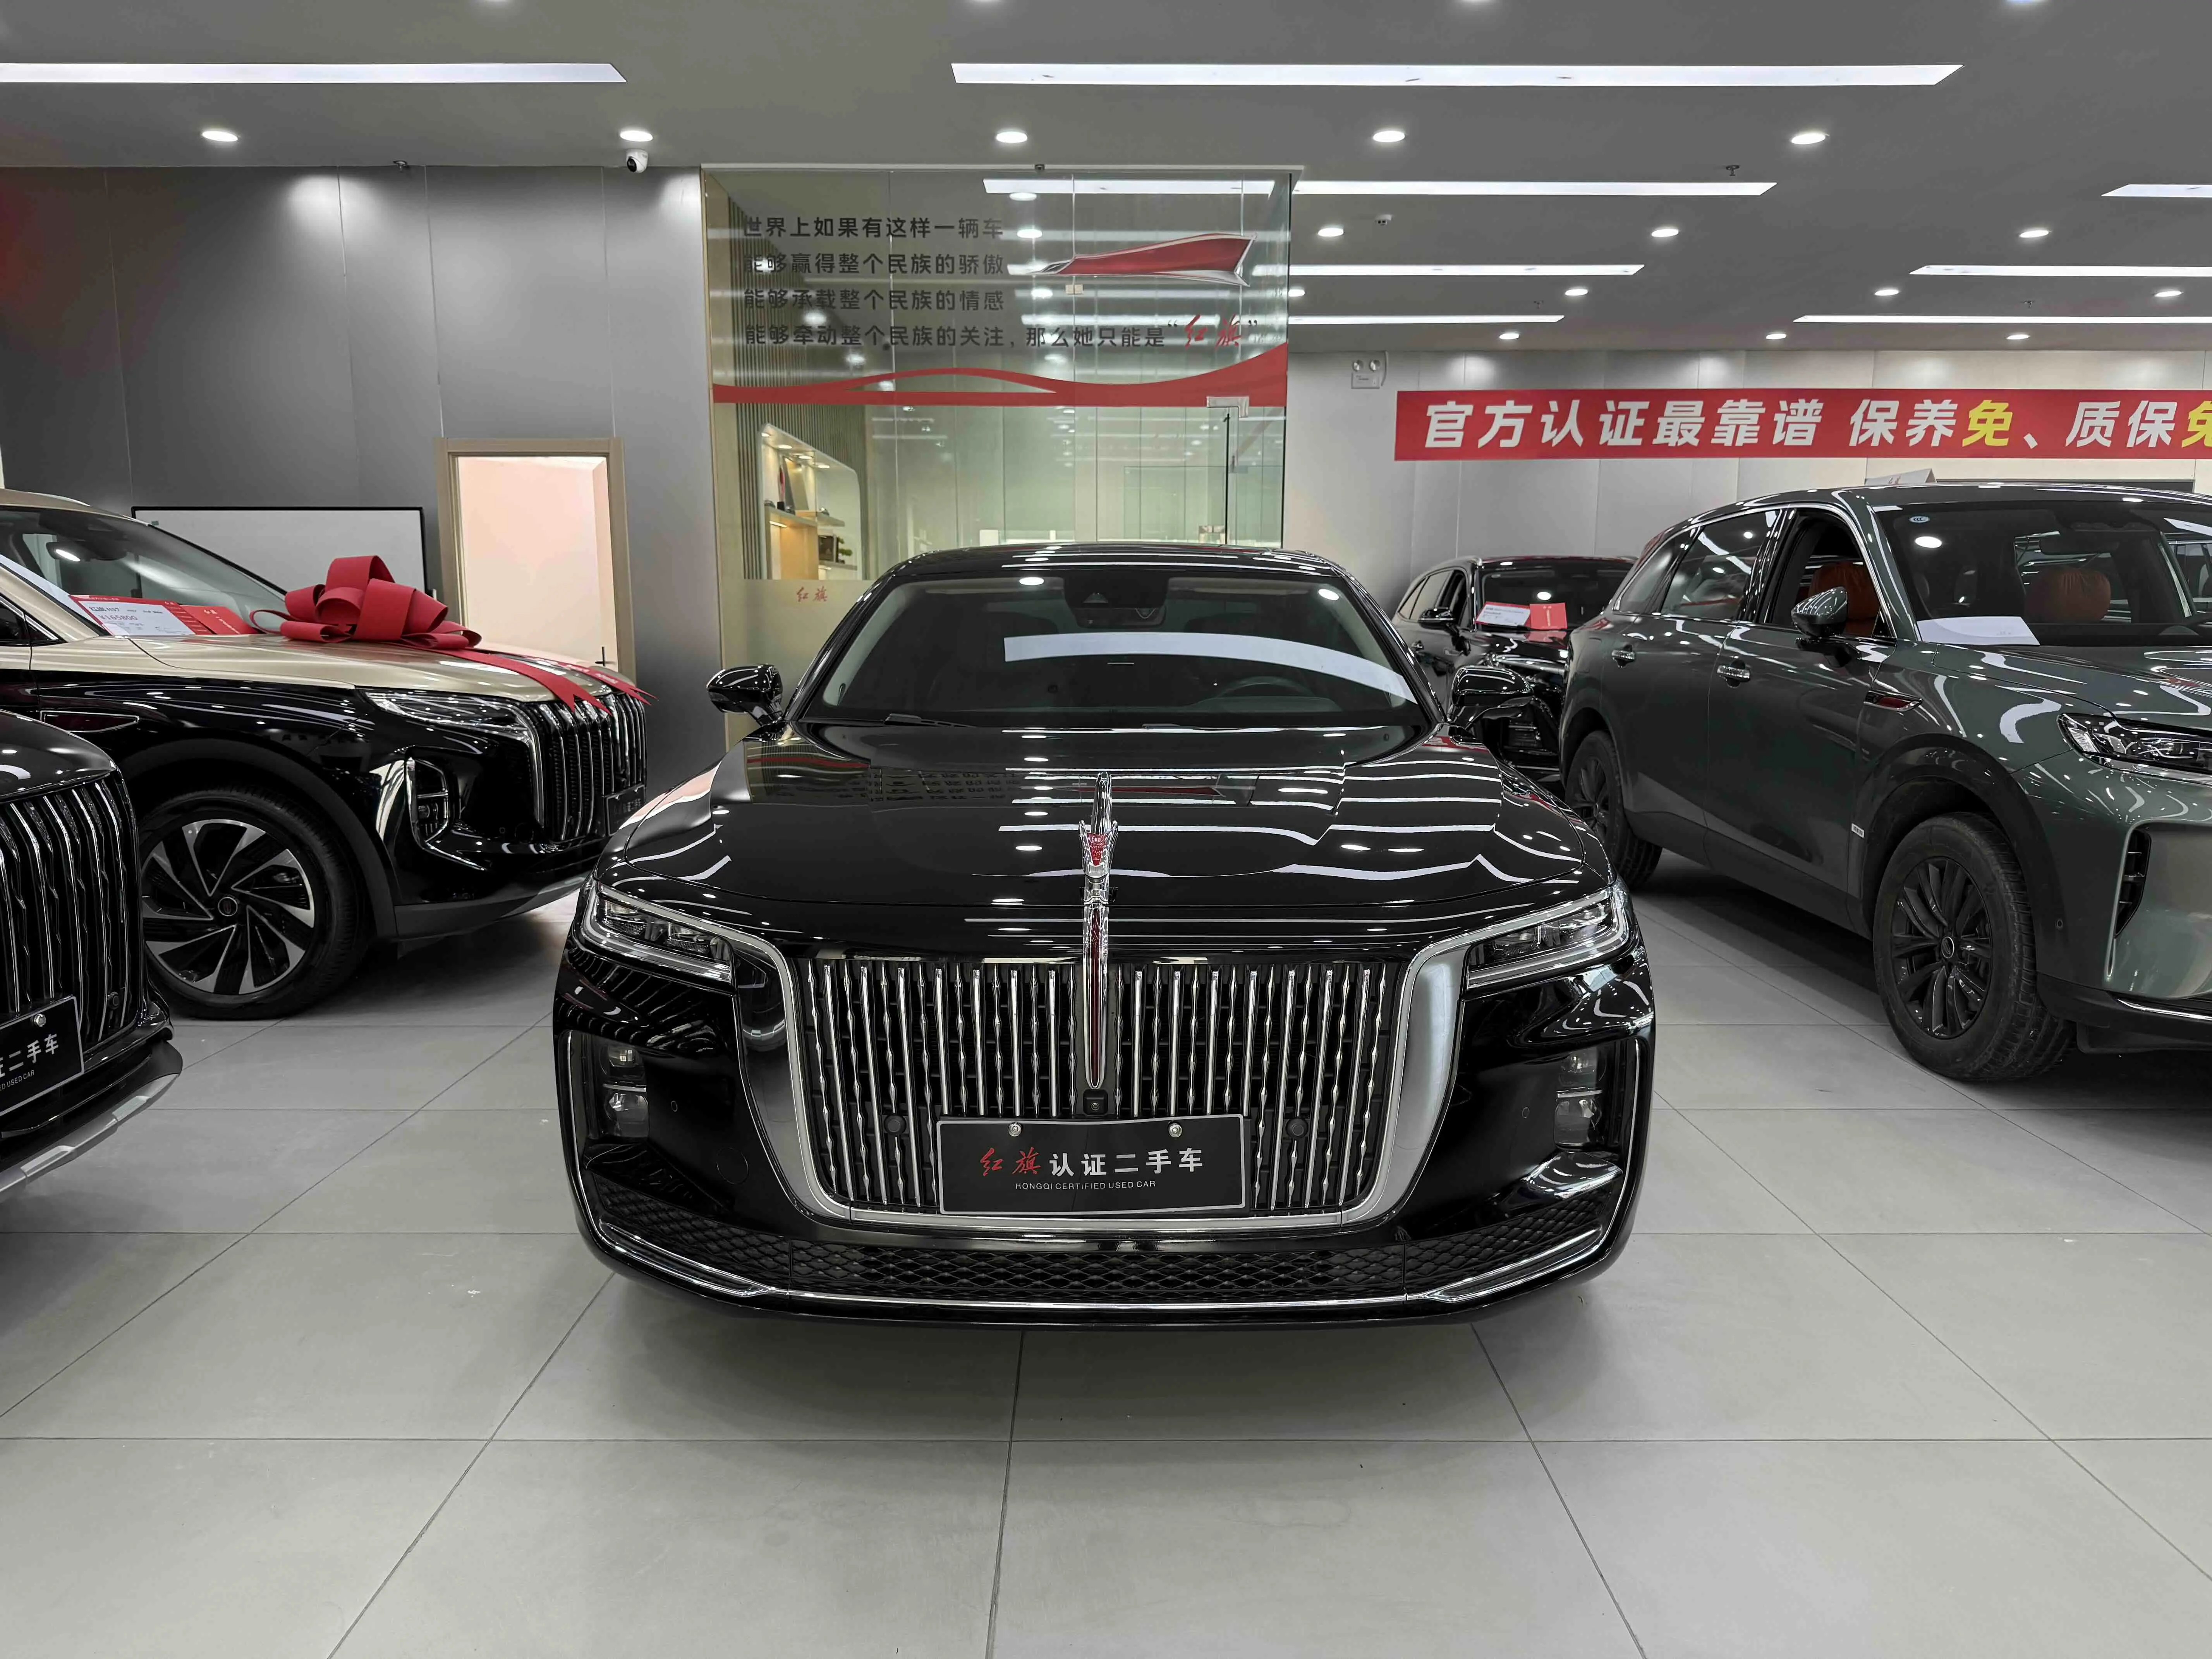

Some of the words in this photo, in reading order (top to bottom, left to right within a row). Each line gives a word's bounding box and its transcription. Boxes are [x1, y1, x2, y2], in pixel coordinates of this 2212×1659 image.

[744, 216, 1004, 239] 世界上如果有这样一辆车
[744, 253, 1004, 275] 能够赢得整个民族的骄傲
[744, 289, 1005, 311] 能够承载整个民族的情感
[1425, 399, 1822, 448] 官方认证最靠谱
[7, 1076, 22, 1087] USED
[23, 1070, 34, 1079] CAR
[980, 1147, 1203, 1176] 红旗认证二手车
